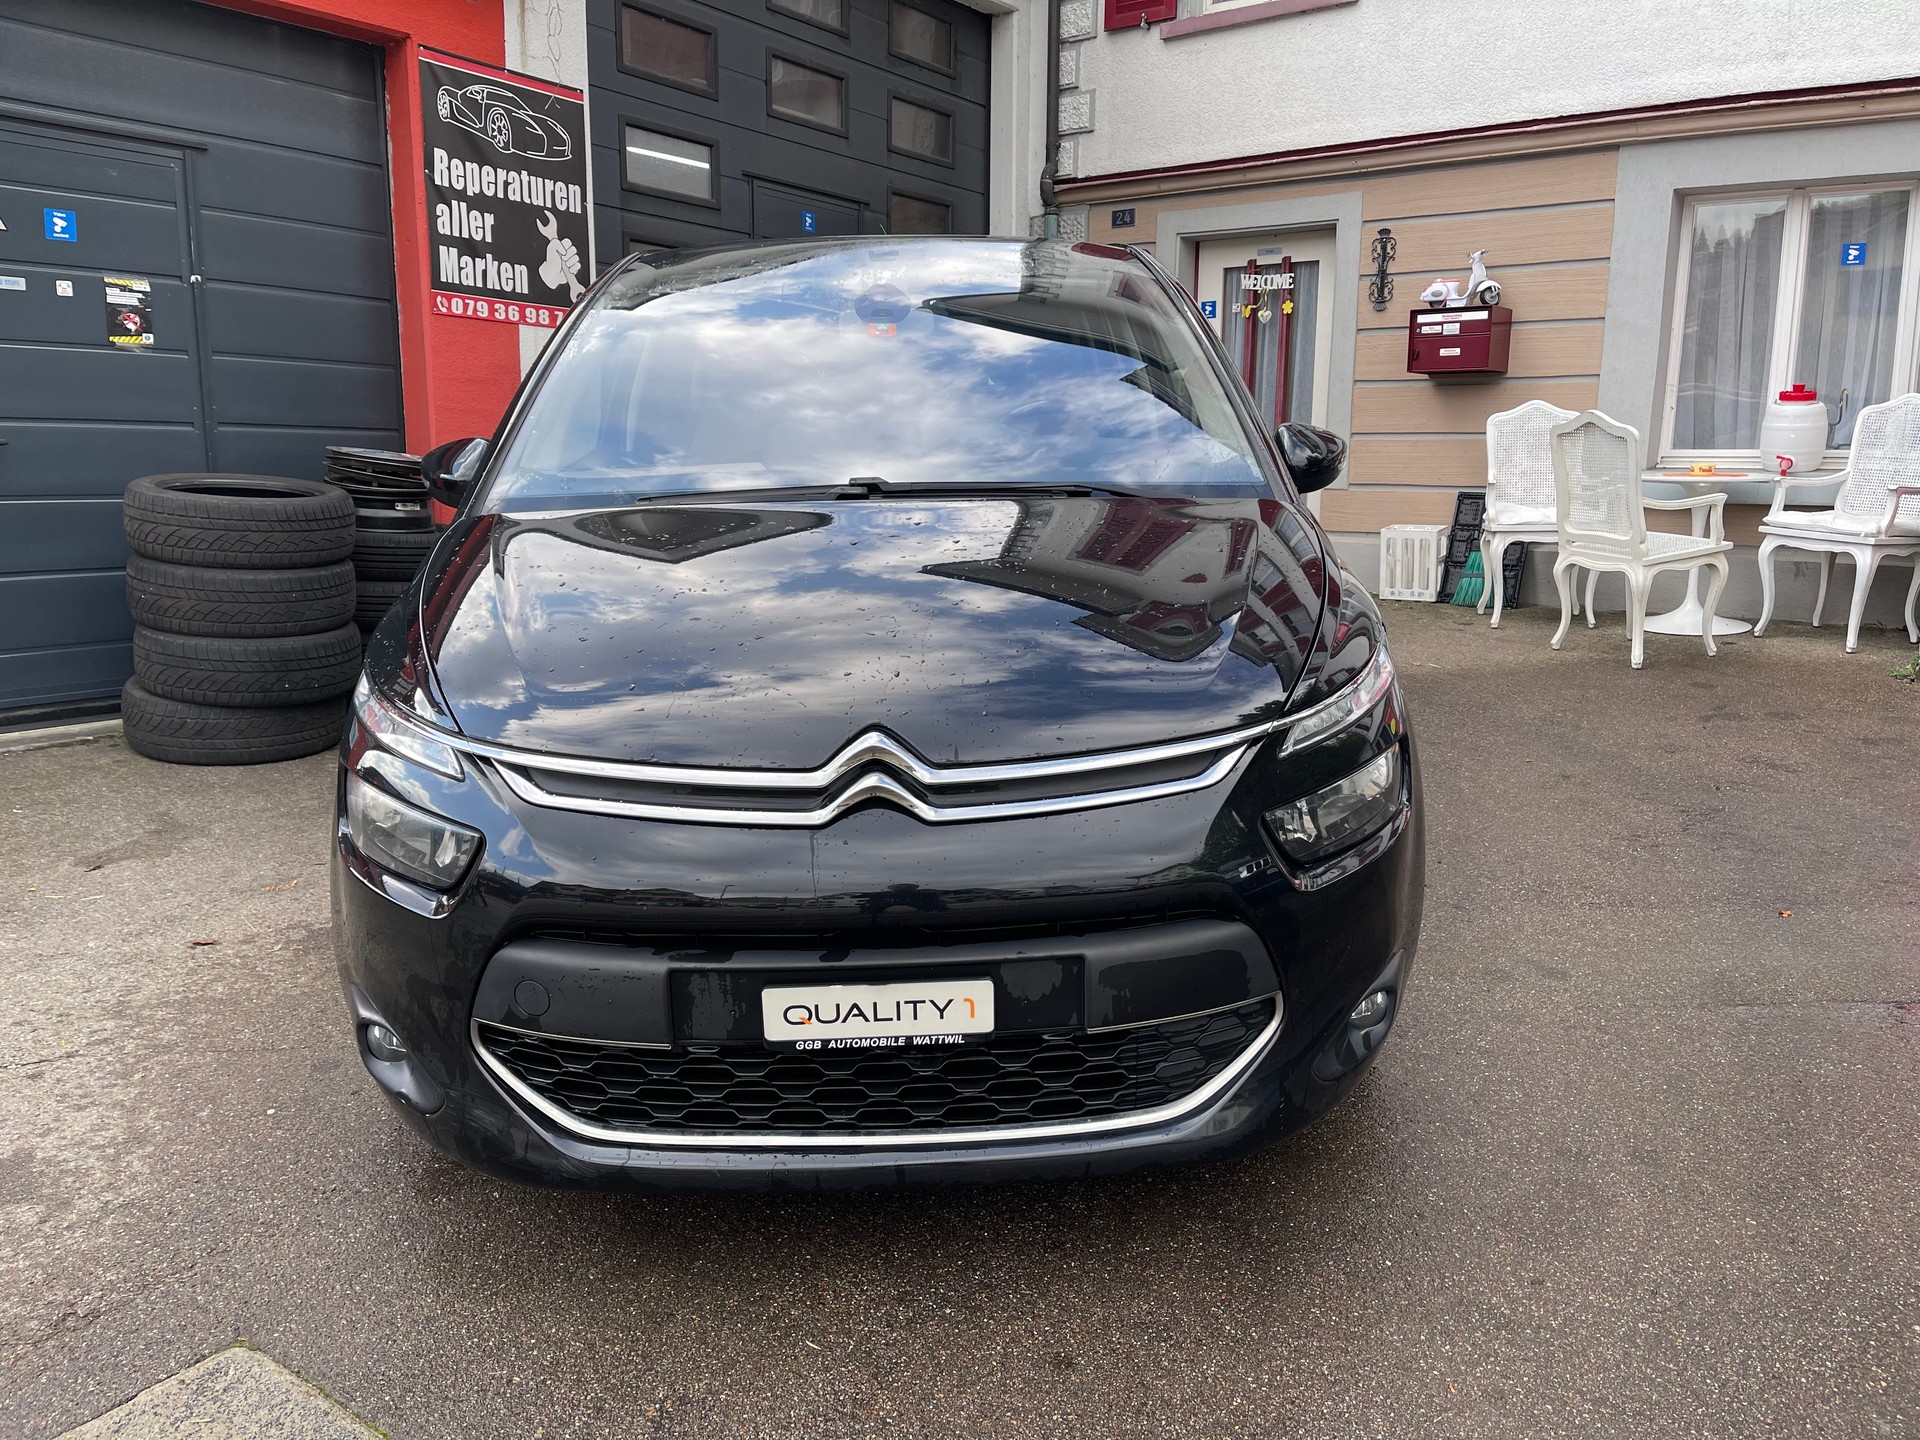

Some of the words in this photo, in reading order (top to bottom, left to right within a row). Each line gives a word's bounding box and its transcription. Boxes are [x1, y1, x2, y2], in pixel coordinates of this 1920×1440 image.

[433, 147, 581, 214] Reperaturen
[436, 199, 494, 243] aller
[1115, 212, 1131, 224] 24
[439, 246, 529, 294] Marken
[1240, 273, 1295, 290] WELCOME
[450, 297, 489, 318] 079
[493, 303, 520, 321] 36
[525, 307, 550, 325] 98
[783, 998, 954, 1026] QUALITY
[795, 1039, 822, 1051] GGB
[828, 1037, 906, 1049] AUTOMOBILE
[912, 1034, 965, 1046] WATTWIL
